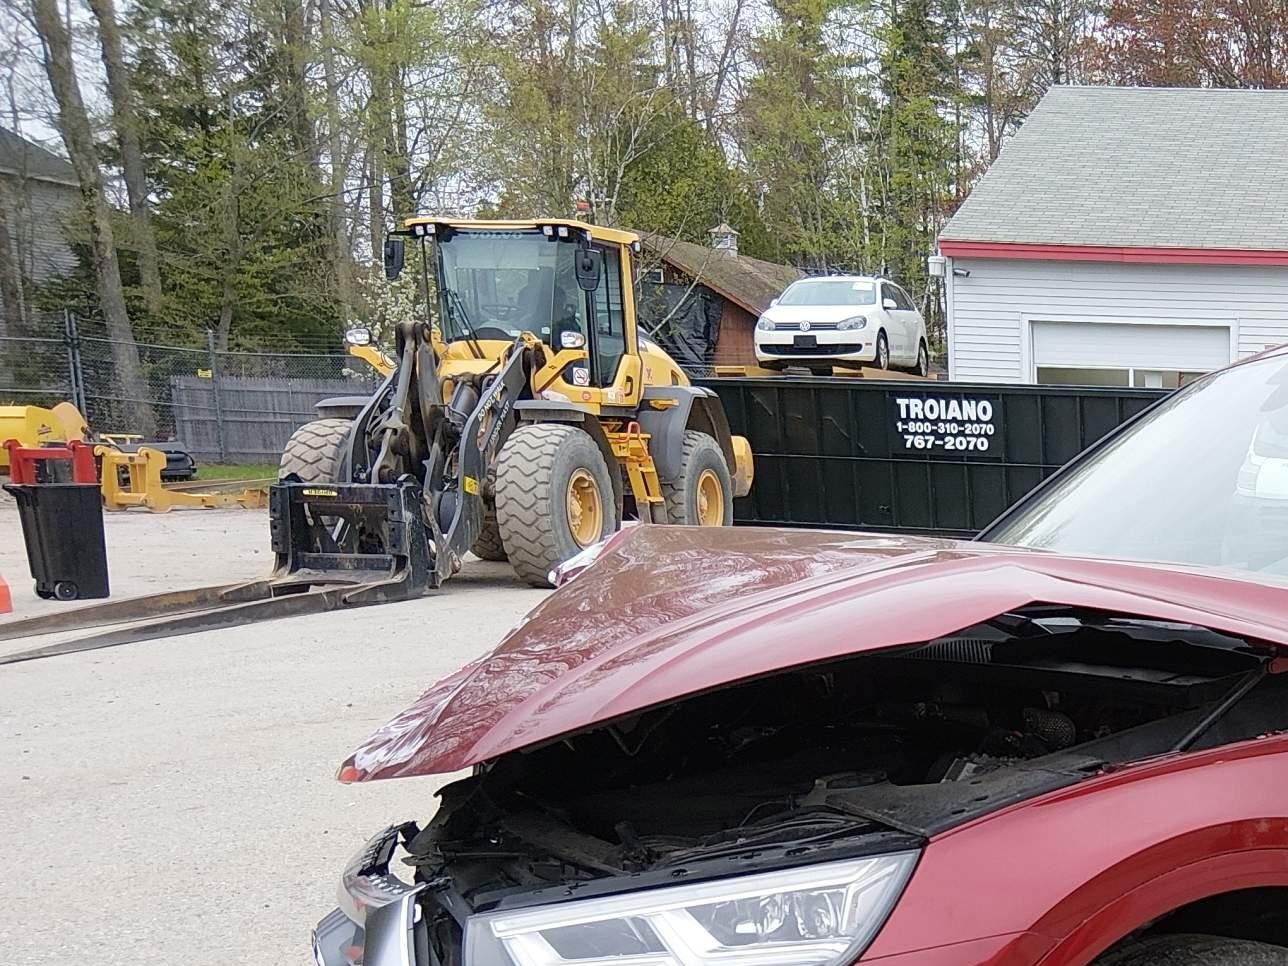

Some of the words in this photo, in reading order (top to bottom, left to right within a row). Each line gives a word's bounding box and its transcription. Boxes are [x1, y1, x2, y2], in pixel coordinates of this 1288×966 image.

[468, 231, 522, 239] VOLVO
[896, 398, 993, 421] TROIANO
[896, 421, 995, 435] 1-800-310-2070
[903, 435, 989, 451] 767-2070
